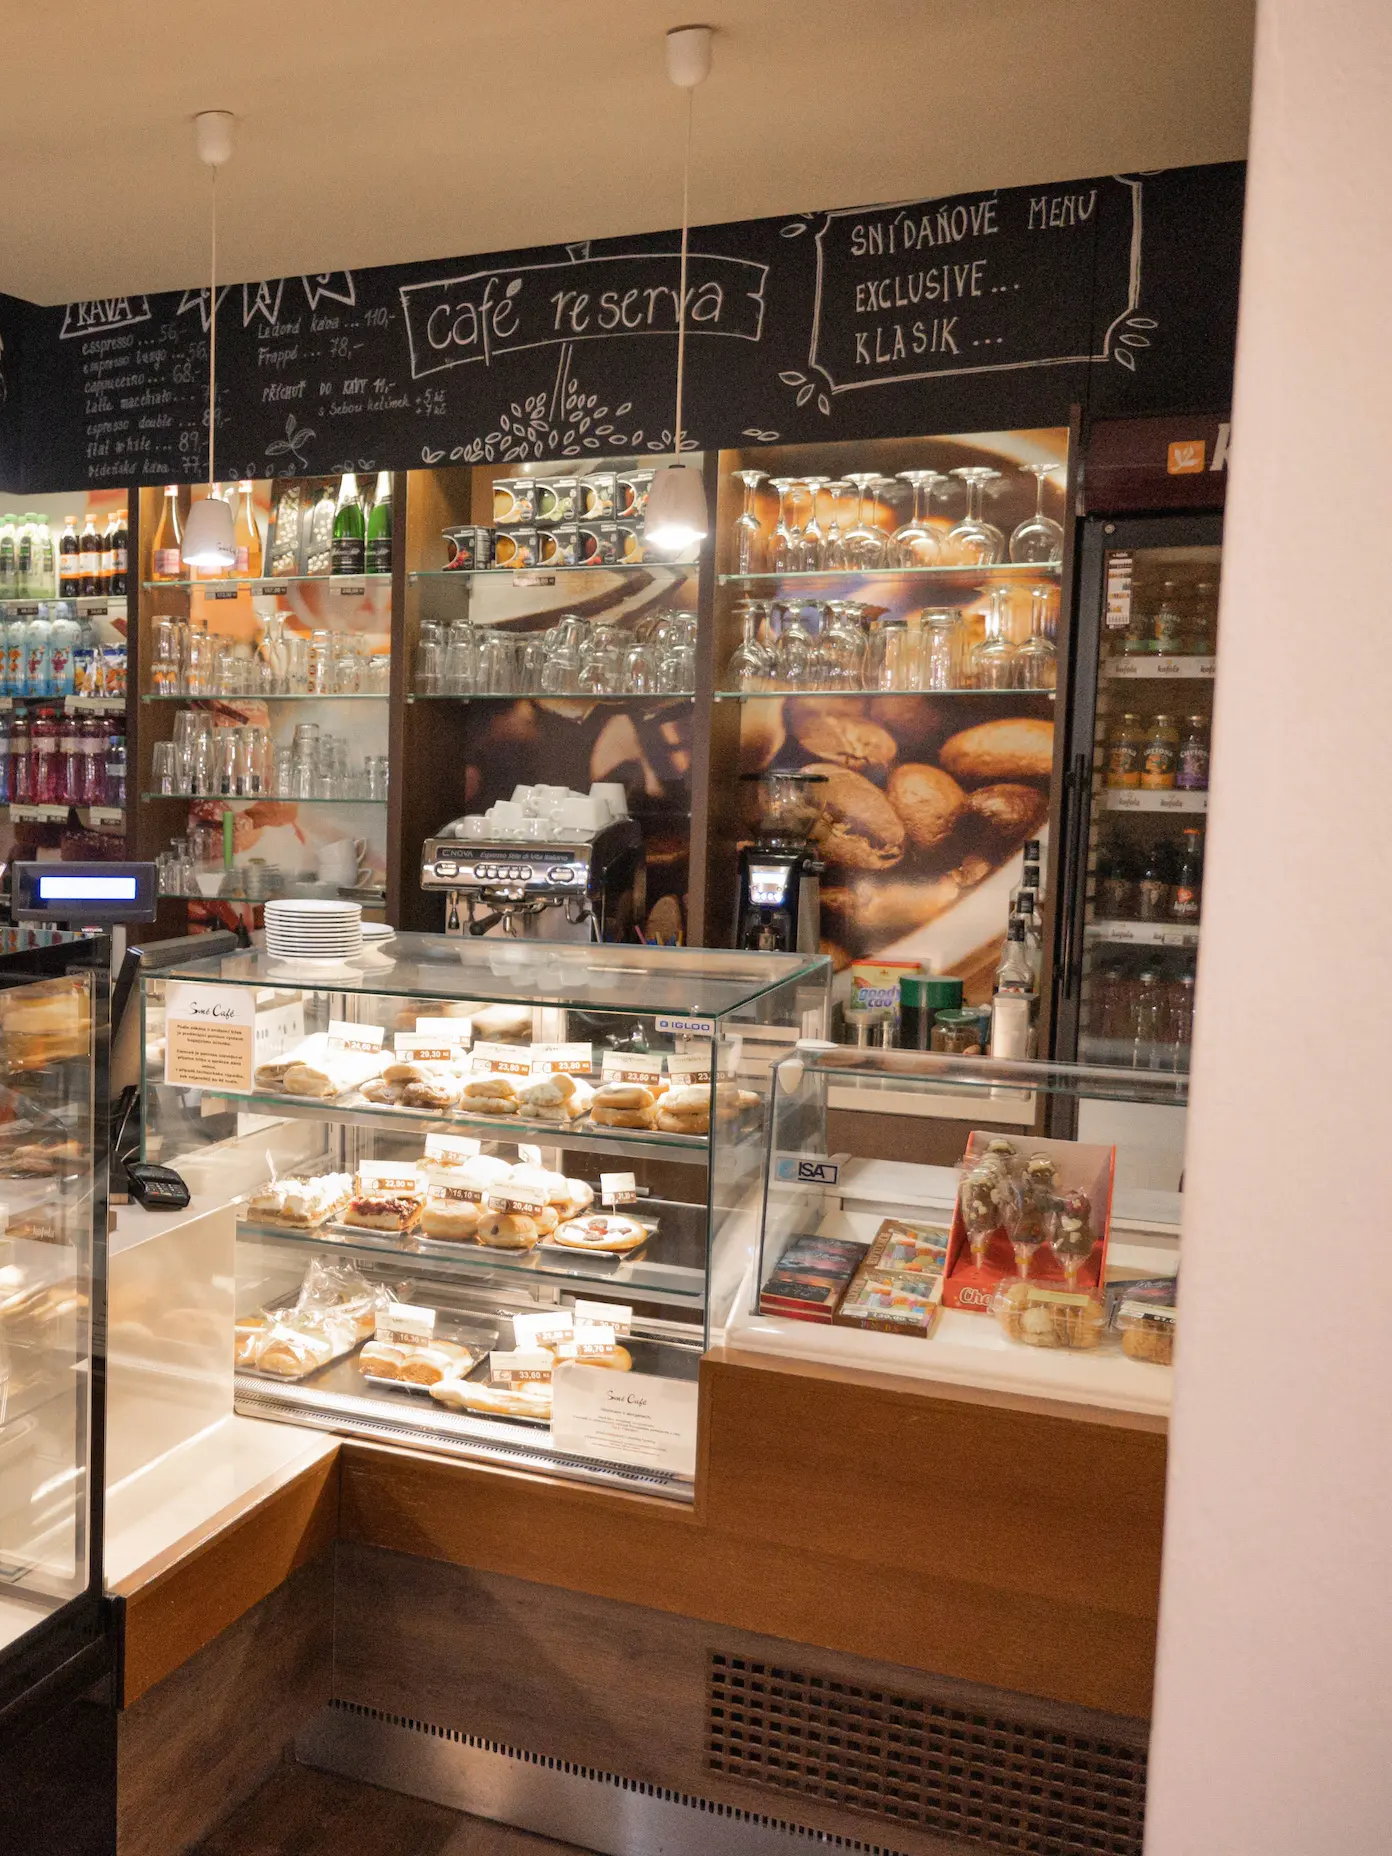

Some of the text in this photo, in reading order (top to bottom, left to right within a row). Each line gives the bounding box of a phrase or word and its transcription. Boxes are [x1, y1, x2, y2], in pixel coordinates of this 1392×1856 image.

[1028, 191, 1098, 230] MENU
[551, 282, 723, 332] reserva
[855, 317, 959, 364] KLASIK
[671, 1020, 710, 1031] IGLOO
[798, 1161, 826, 1179] ISA
